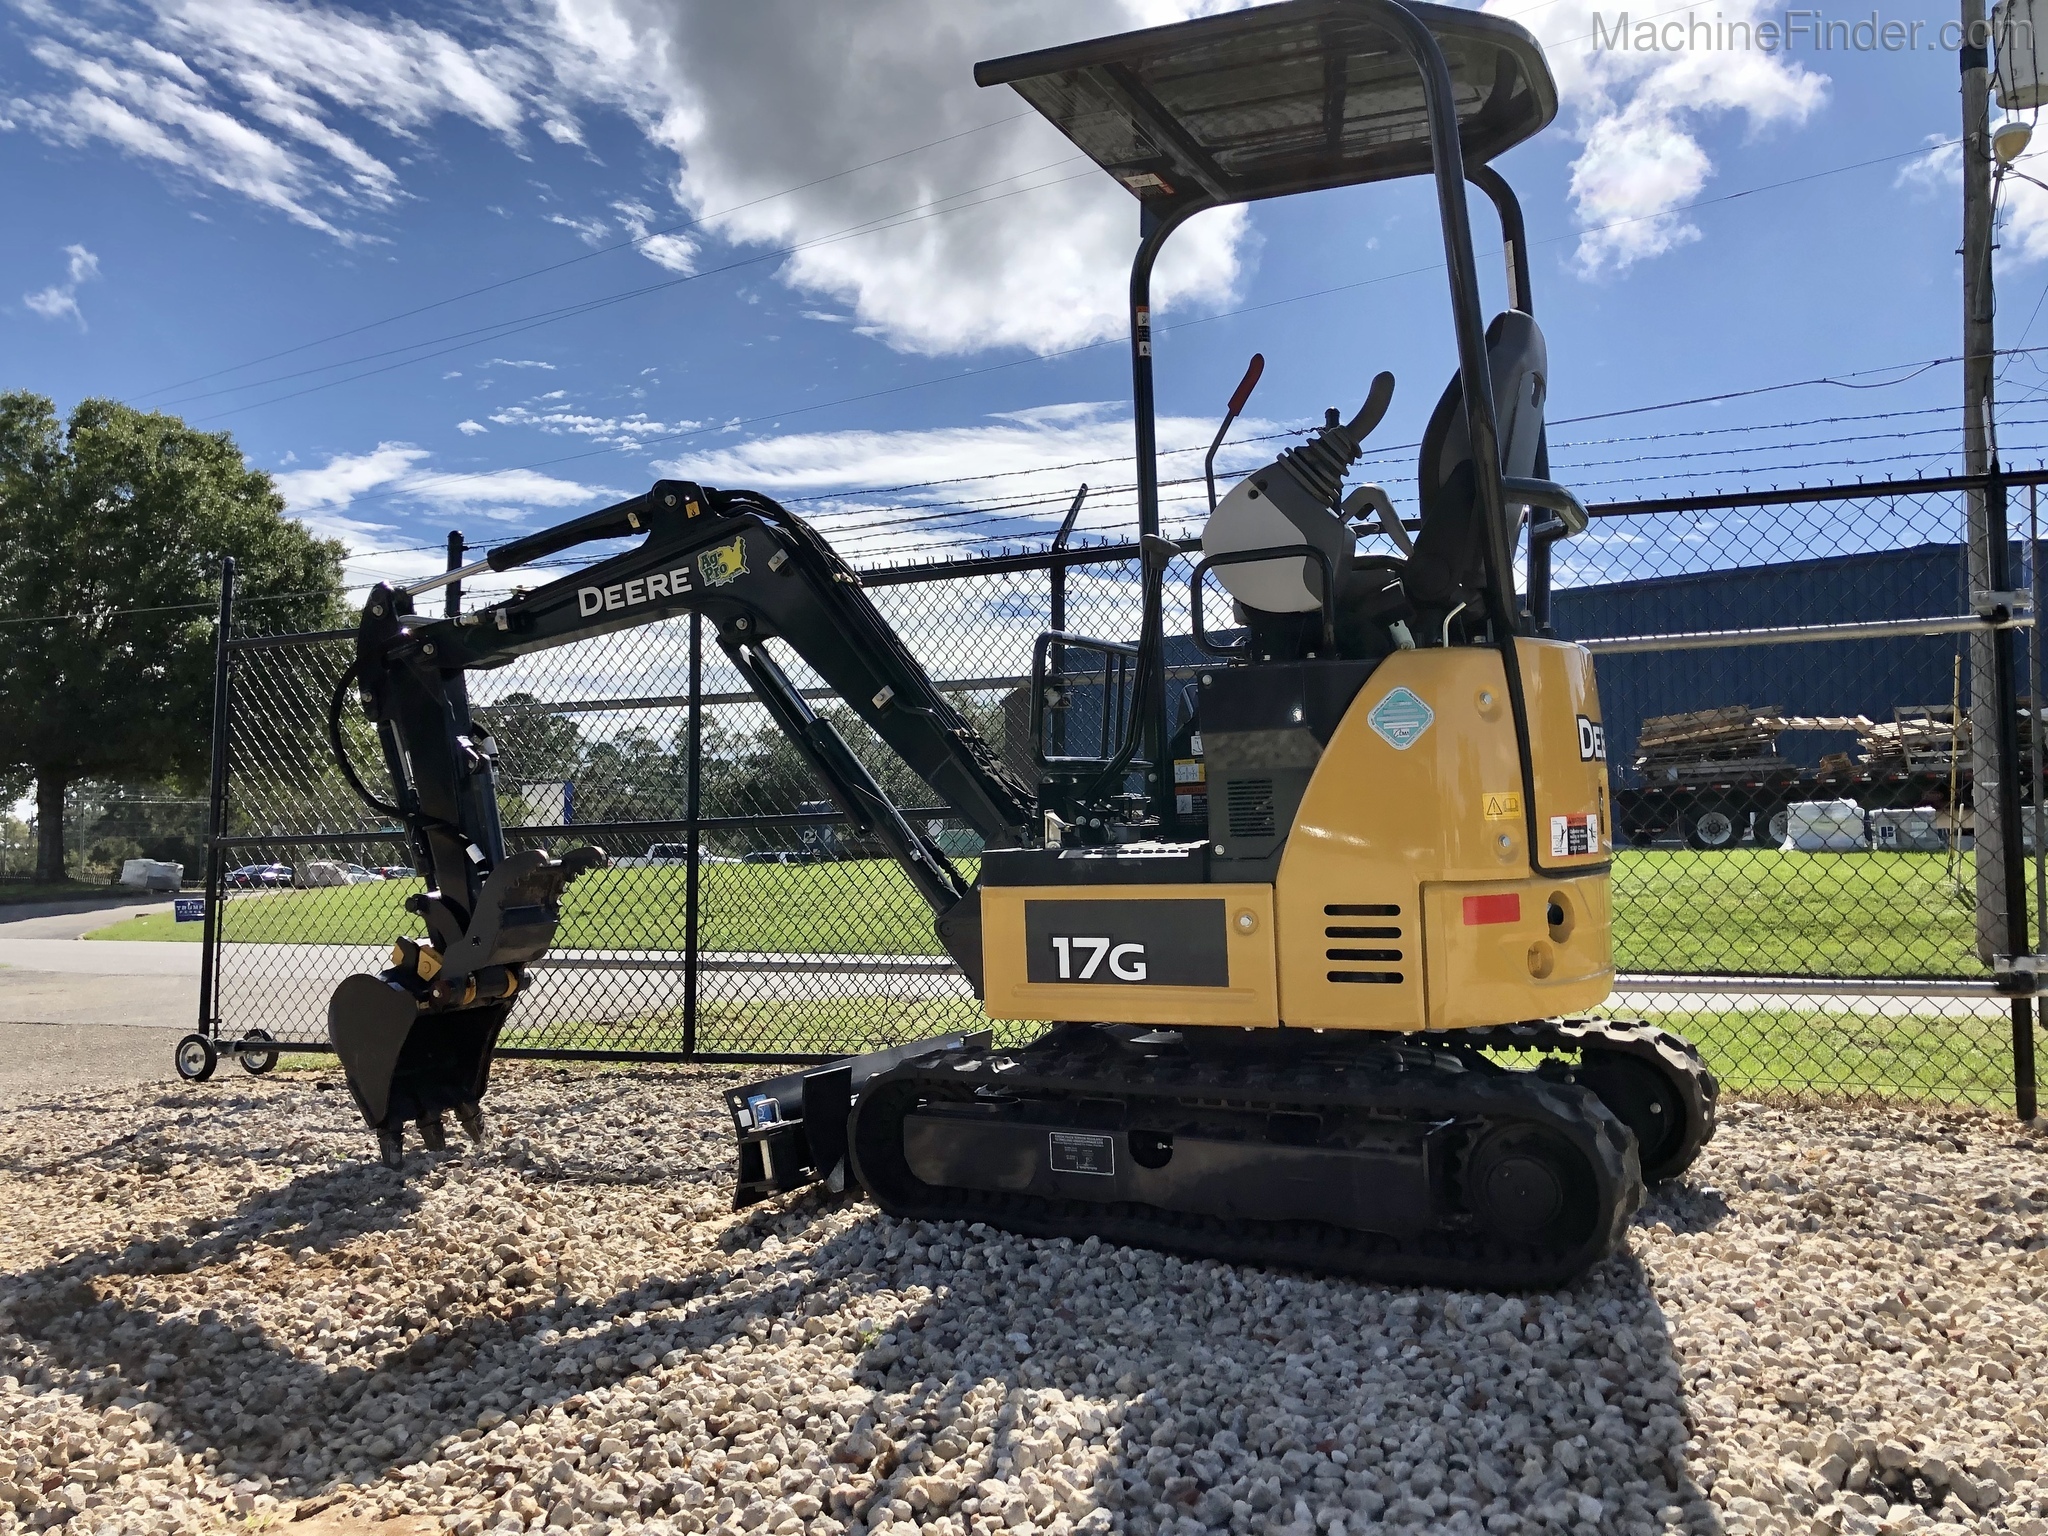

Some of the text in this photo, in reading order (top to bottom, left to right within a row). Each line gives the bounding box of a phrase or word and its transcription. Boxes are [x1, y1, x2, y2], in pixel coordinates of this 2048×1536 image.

[578, 567, 692, 617] DEERE
[704, 563, 728, 582] Pro
[1053, 937, 1147, 981] 17G
